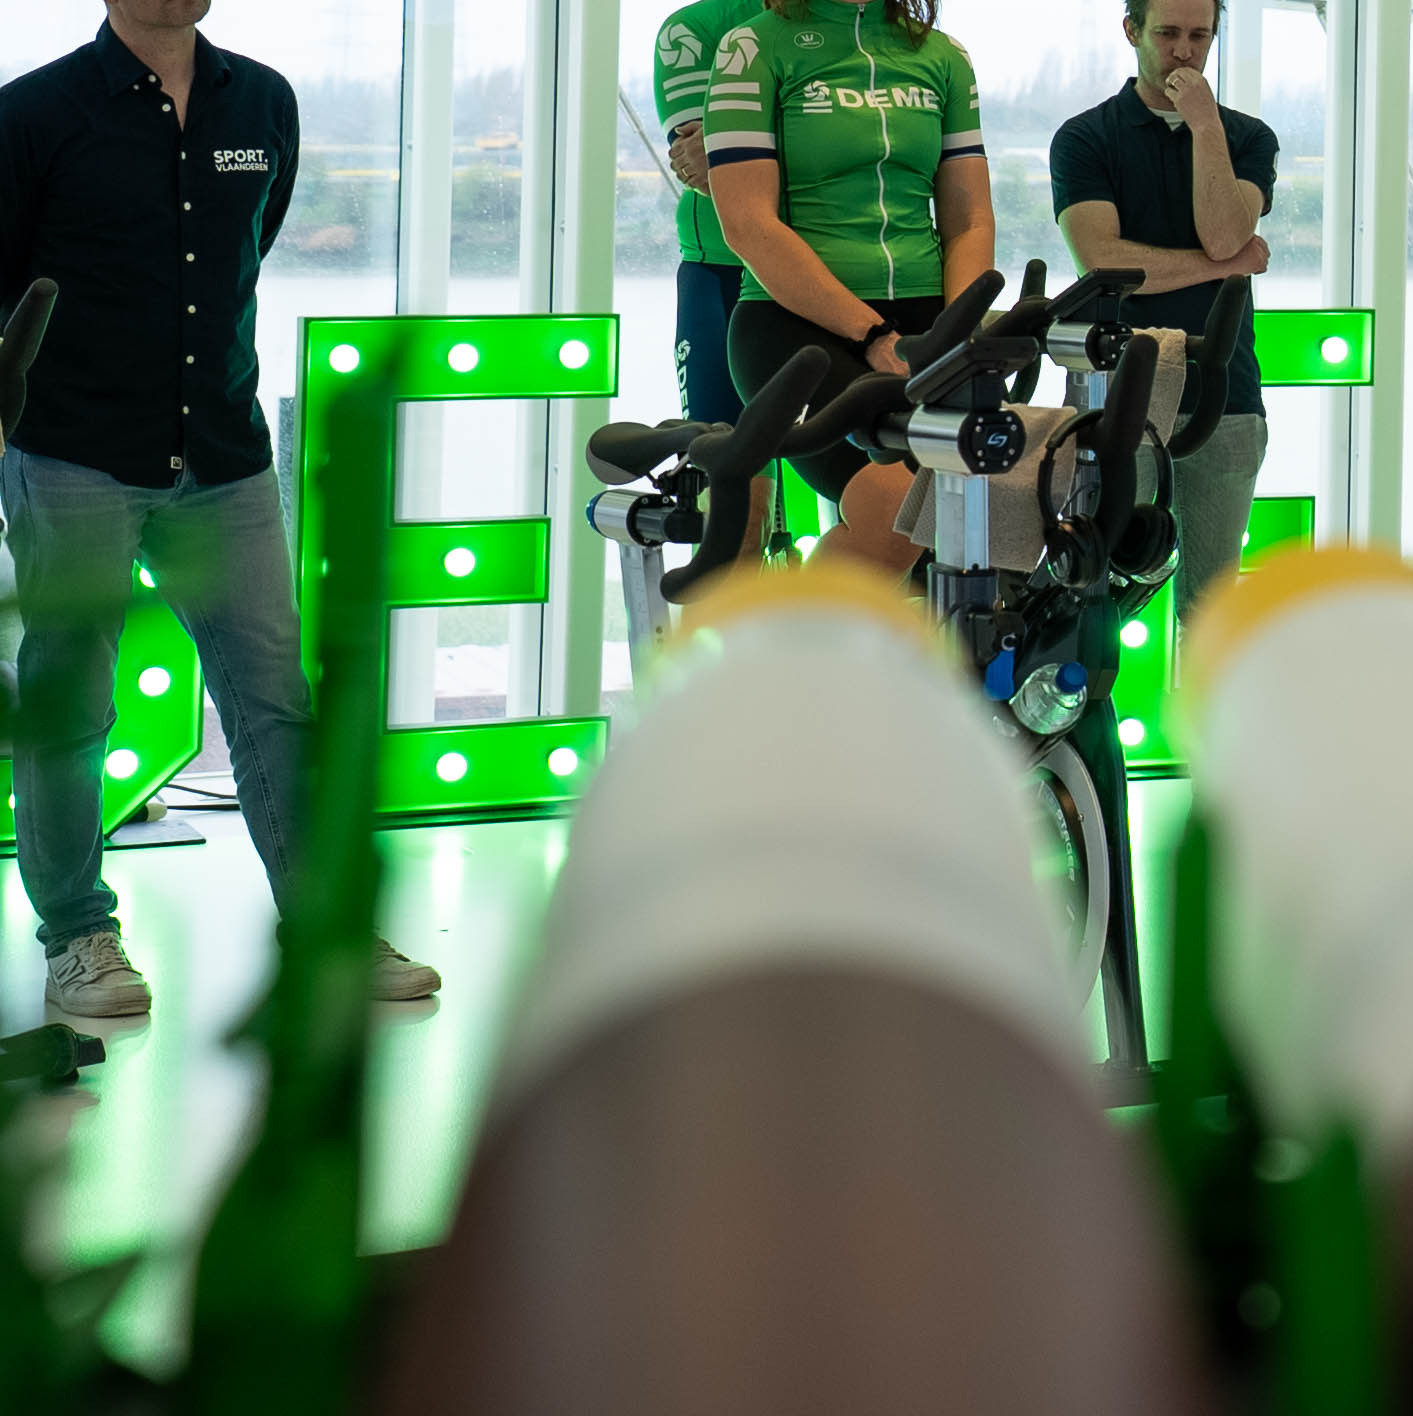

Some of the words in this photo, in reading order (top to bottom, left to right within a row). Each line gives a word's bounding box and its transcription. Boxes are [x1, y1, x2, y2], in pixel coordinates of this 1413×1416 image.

[835, 86, 940, 110] DEME
[213, 149, 269, 164] SPORT.
[215, 163, 269, 172] VLAANDEREN
